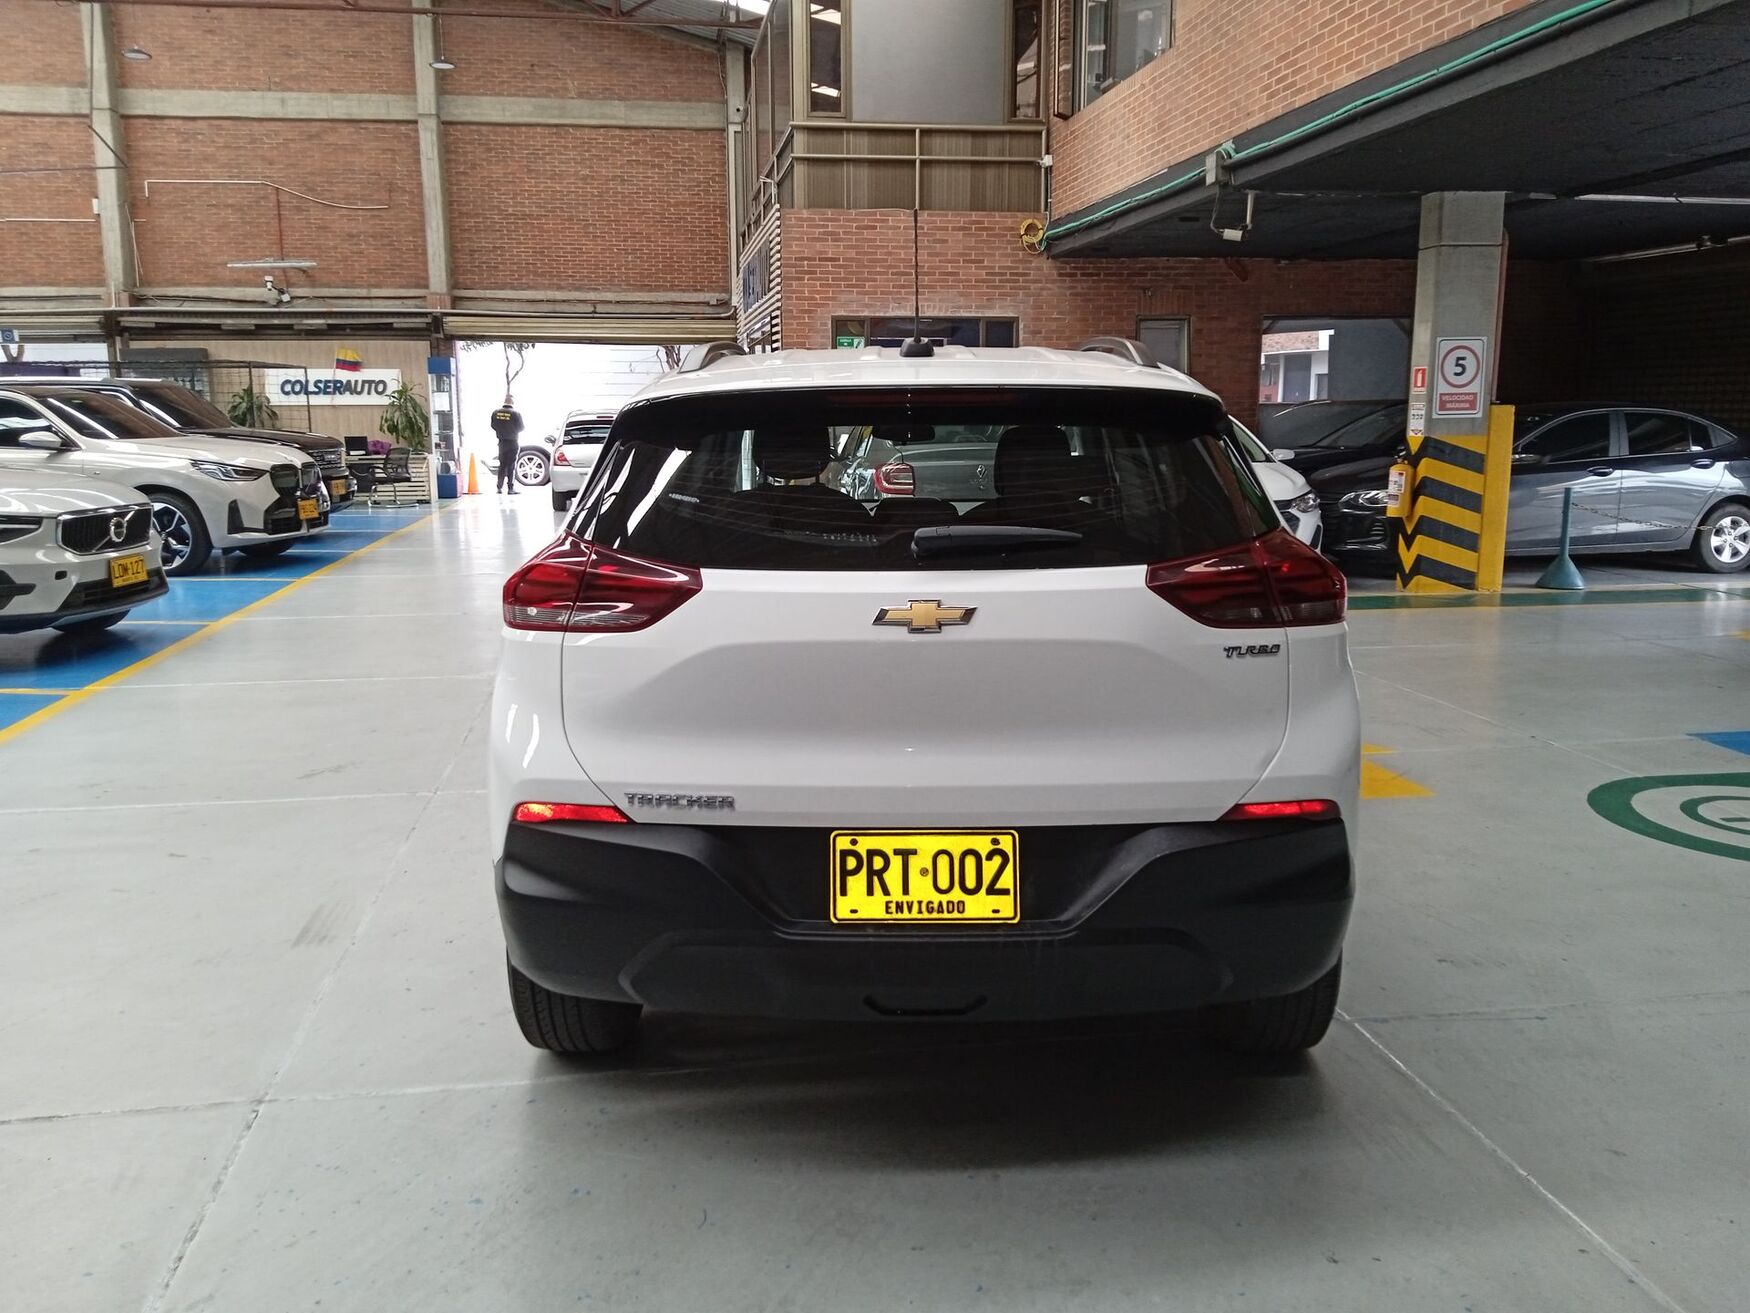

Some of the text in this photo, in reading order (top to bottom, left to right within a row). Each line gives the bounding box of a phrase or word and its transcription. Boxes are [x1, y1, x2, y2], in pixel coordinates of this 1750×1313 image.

[1453, 356, 1467, 377] 5
[280, 378, 388, 396] COLSERAUTO
[1223, 644, 1281, 658] TURBO
[624, 793, 735, 810] TRACKER
[885, 900, 966, 914] ENVIGADO
